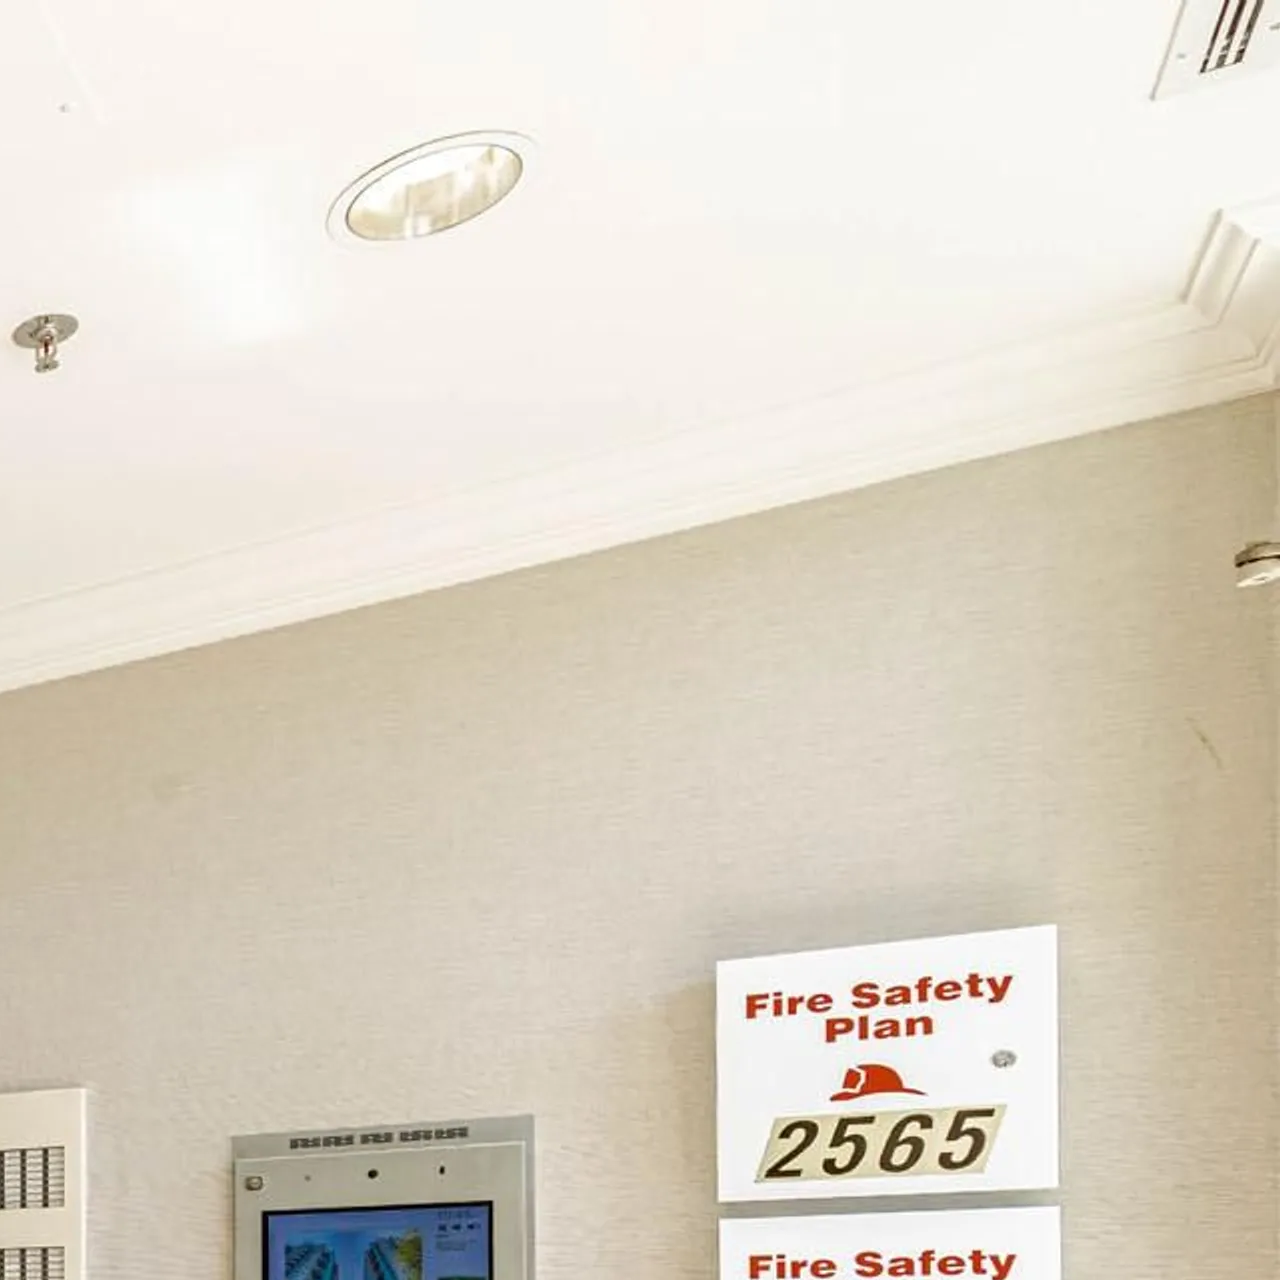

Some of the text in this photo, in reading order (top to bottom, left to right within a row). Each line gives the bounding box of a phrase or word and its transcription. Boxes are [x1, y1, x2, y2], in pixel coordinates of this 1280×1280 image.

[745, 972, 1014, 1019] Fire Safety
[825, 1014, 934, 1043] Plan
[765, 1108, 996, 1179] 2565
[748, 1250, 1017, 1280] Fire Safety
